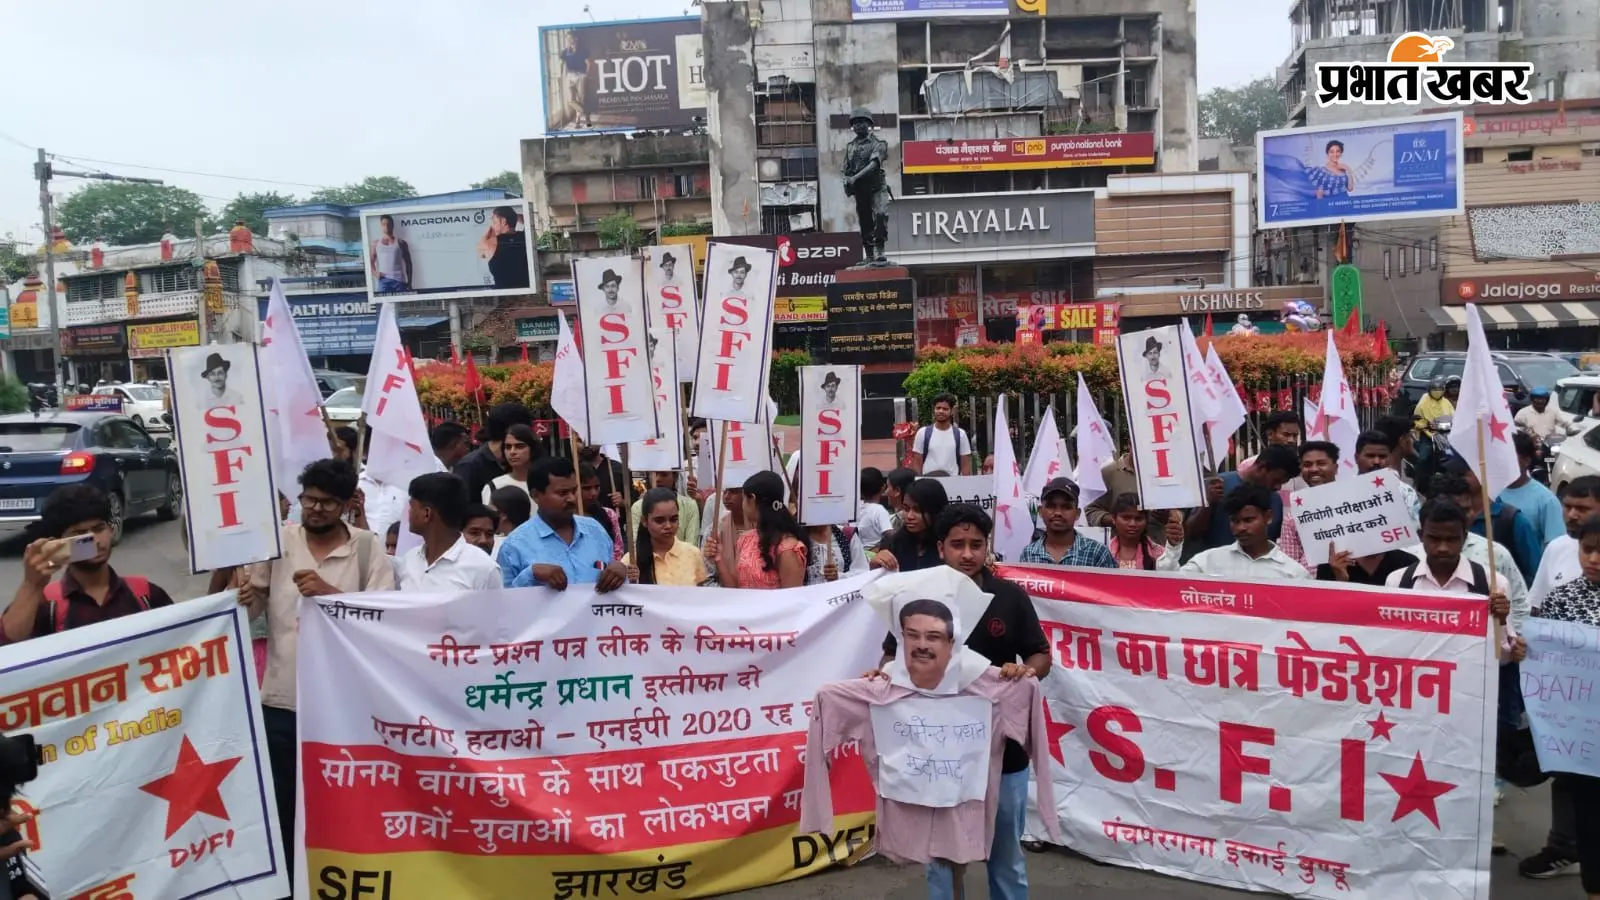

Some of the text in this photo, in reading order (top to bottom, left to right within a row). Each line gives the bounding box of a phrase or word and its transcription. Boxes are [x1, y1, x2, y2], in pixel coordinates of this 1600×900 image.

[594, 55, 671, 94] HOT
[936, 146, 959, 155] पंजाब
[992, 140, 1007, 153] बैंक
[1051, 138, 1122, 152] punjab national bank
[1400, 149, 1440, 164] DNM
[400, 215, 470, 227] MACROMAN
[912, 207, 1050, 243] FIRAYALAL
[791, 271, 837, 287] Boutiqu
[958, 276, 978, 294] SAL
[1481, 283, 1561, 299] Jalajoga
[292, 302, 376, 316] ALTH HOME
[660, 285, 688, 330] SF
[774, 313, 798, 321] RAND
[917, 297, 948, 319] SALE
[1061, 308, 1097, 328] SALE
[1179, 292, 1265, 311] VISHNEES
[711, 297, 752, 392] SFI
[600, 313, 638, 416] SFI
[1144, 379, 1178, 478] SFI
[204, 404, 253, 529] SFI
[816, 408, 846, 496] SFI
[1297, 490, 1394, 524] प्रतियोगी परीक्षाओं में
[1313, 514, 1388, 540] धांधली बंद करो
[1380, 526, 1411, 543] SFI
[1004, 575, 1055, 593] तंत्रता
[1180, 587, 1236, 607] लोकतंत्र
[592, 603, 644, 617] जनवाद
[1378, 606, 1461, 626] समाजवाद
[427, 625, 799, 667] नीट प्रश्न पत्र लीक के जिम्मेवार
[139, 635, 230, 695] सभा
[1113, 631, 1171, 680] का
[1180, 638, 1263, 691] छात्र
[1274, 631, 1457, 714] फेडरेशन
[464, 665, 763, 712] धर्मेन्द्र प्रधान इस्तीफा दो
[1522, 671, 1593, 702] DEATH
[65, 725, 98, 756] of
[106, 707, 183, 746] India
[371, 715, 455, 754] एनटीए
[465, 719, 545, 754] हटाओ
[586, 707, 671, 749] एनईपी
[682, 707, 752, 736] 2020
[760, 702, 794, 726] रद्द
[319, 749, 402, 787] सोनम
[416, 763, 526, 808] वांगचुंग
[538, 759, 571, 796] के
[585, 763, 645, 793] साथ
[658, 748, 782, 791] एकजुटता
[1340, 738, 1365, 821] I
[586, 813, 627, 840] का
[640, 796, 772, 836] लोकभवन
[168, 829, 235, 869] DYFI
[1225, 841, 1287, 876] इकाई
[317, 865, 392, 900] SFI
[552, 854, 693, 897] झारखंड
